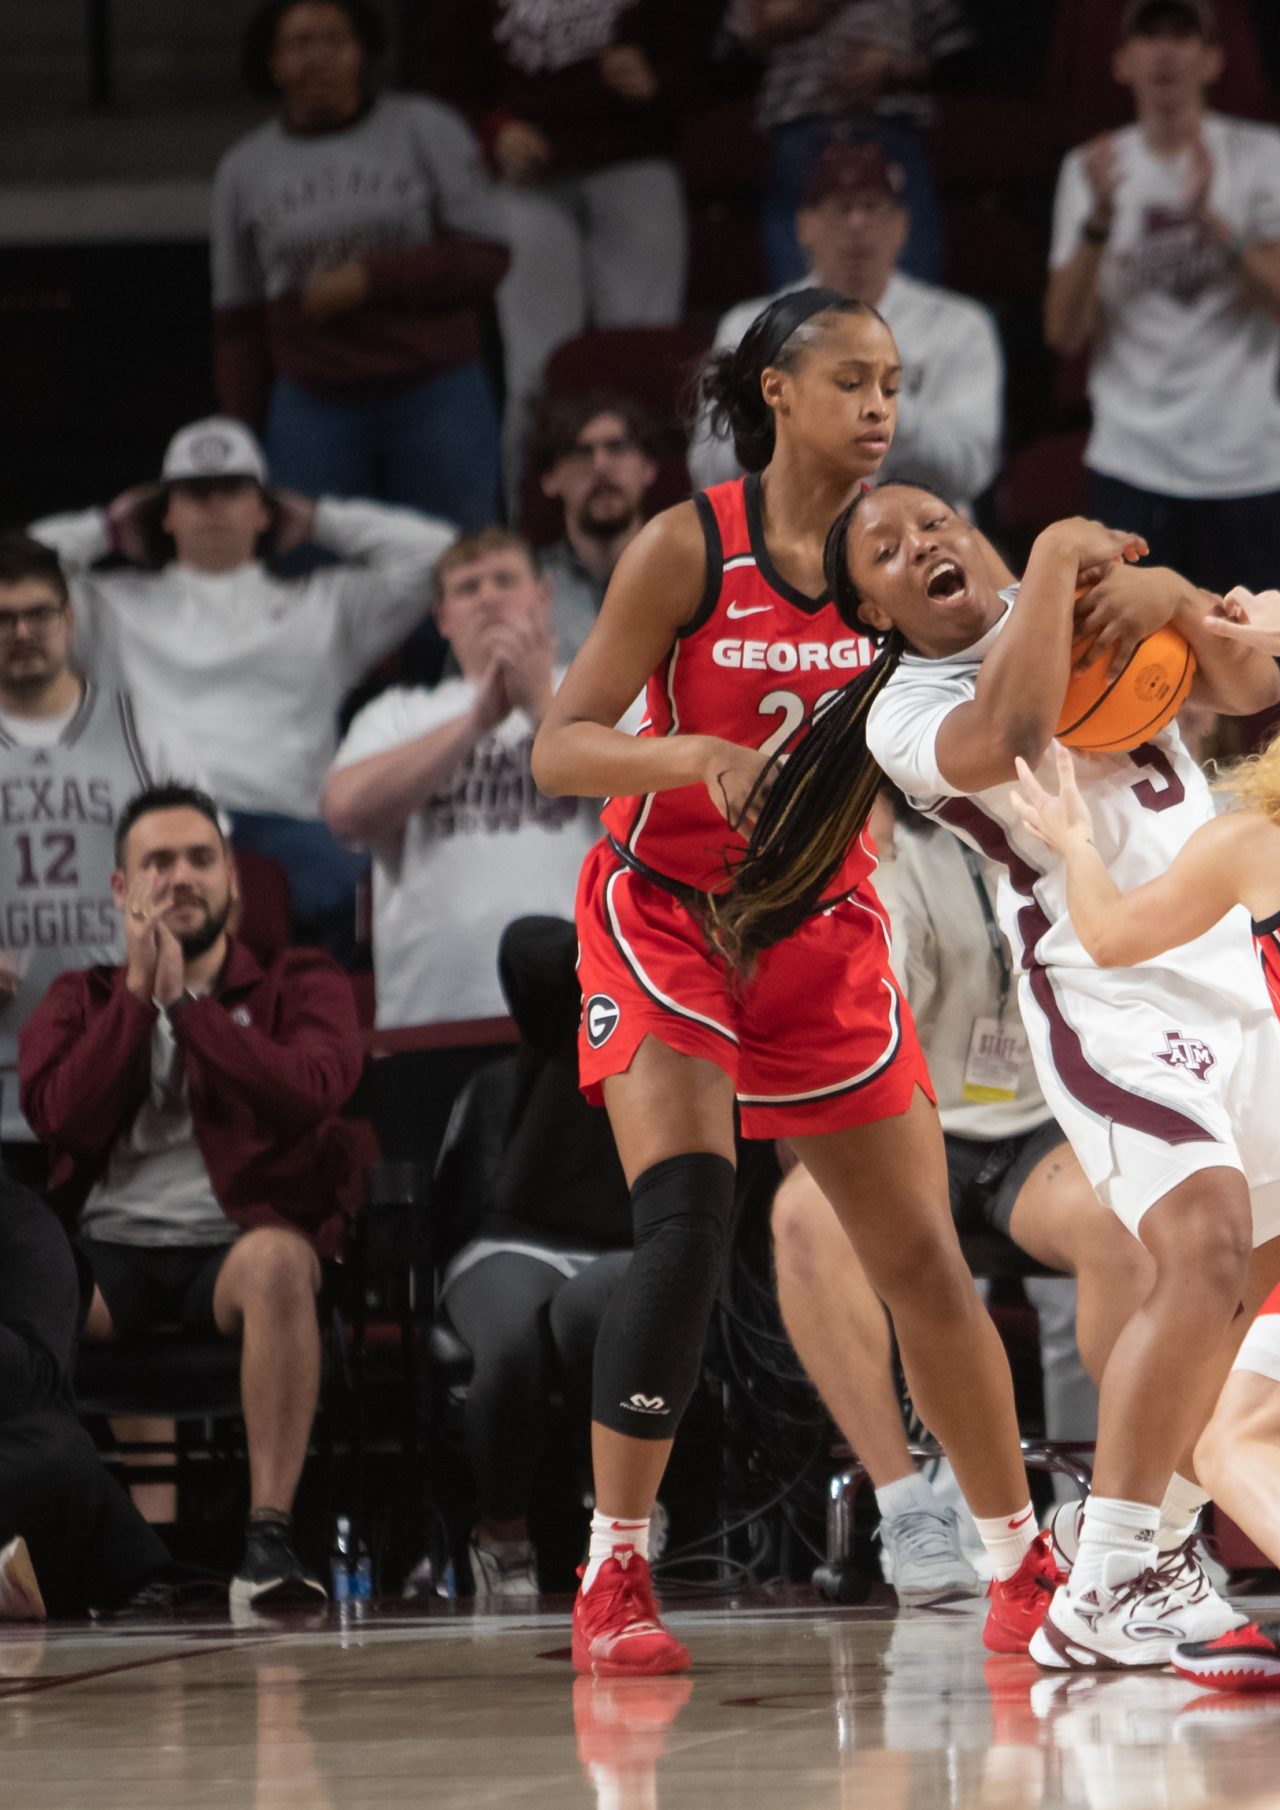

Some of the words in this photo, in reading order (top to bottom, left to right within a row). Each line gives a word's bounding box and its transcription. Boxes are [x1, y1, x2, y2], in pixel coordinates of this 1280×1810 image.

[0, 777, 114, 826] EXAS
[16, 832, 79, 889] 12
[0, 900, 116, 948] GGIES
